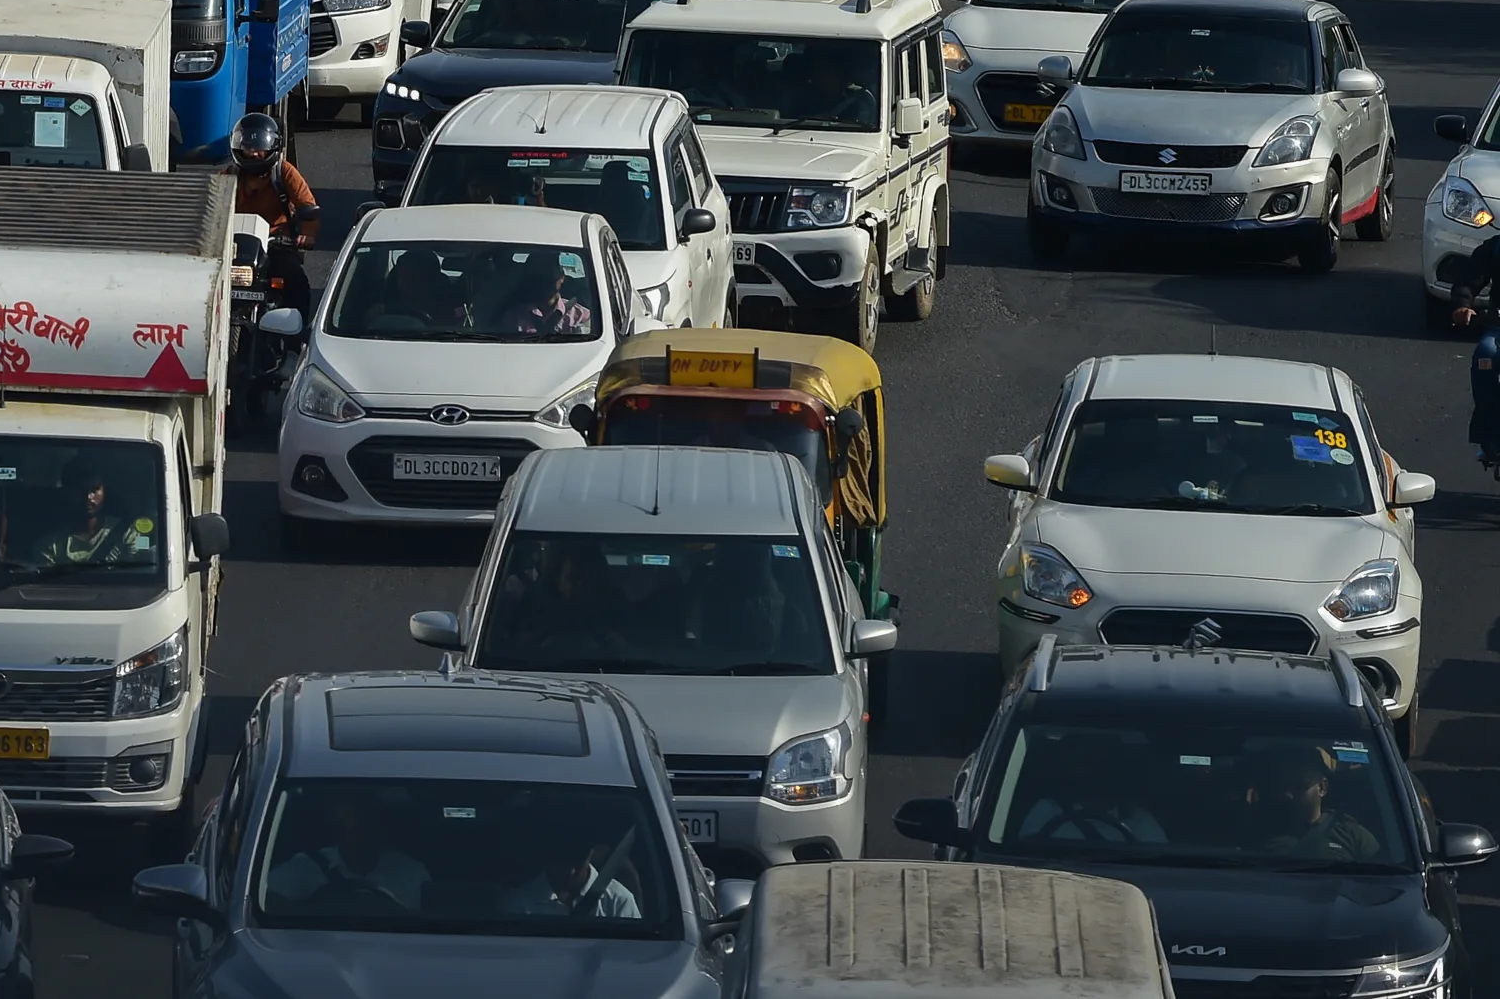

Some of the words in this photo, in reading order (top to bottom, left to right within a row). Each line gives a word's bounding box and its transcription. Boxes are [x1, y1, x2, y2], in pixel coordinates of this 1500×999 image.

[733, 247, 752, 261] 69
[133, 323, 188, 349] लाभ
[672, 360, 690, 373] ON
[699, 359, 742, 373] DUTY
[1314, 429, 1347, 448] 138
[405, 458, 500, 478] DL3CCD0214
